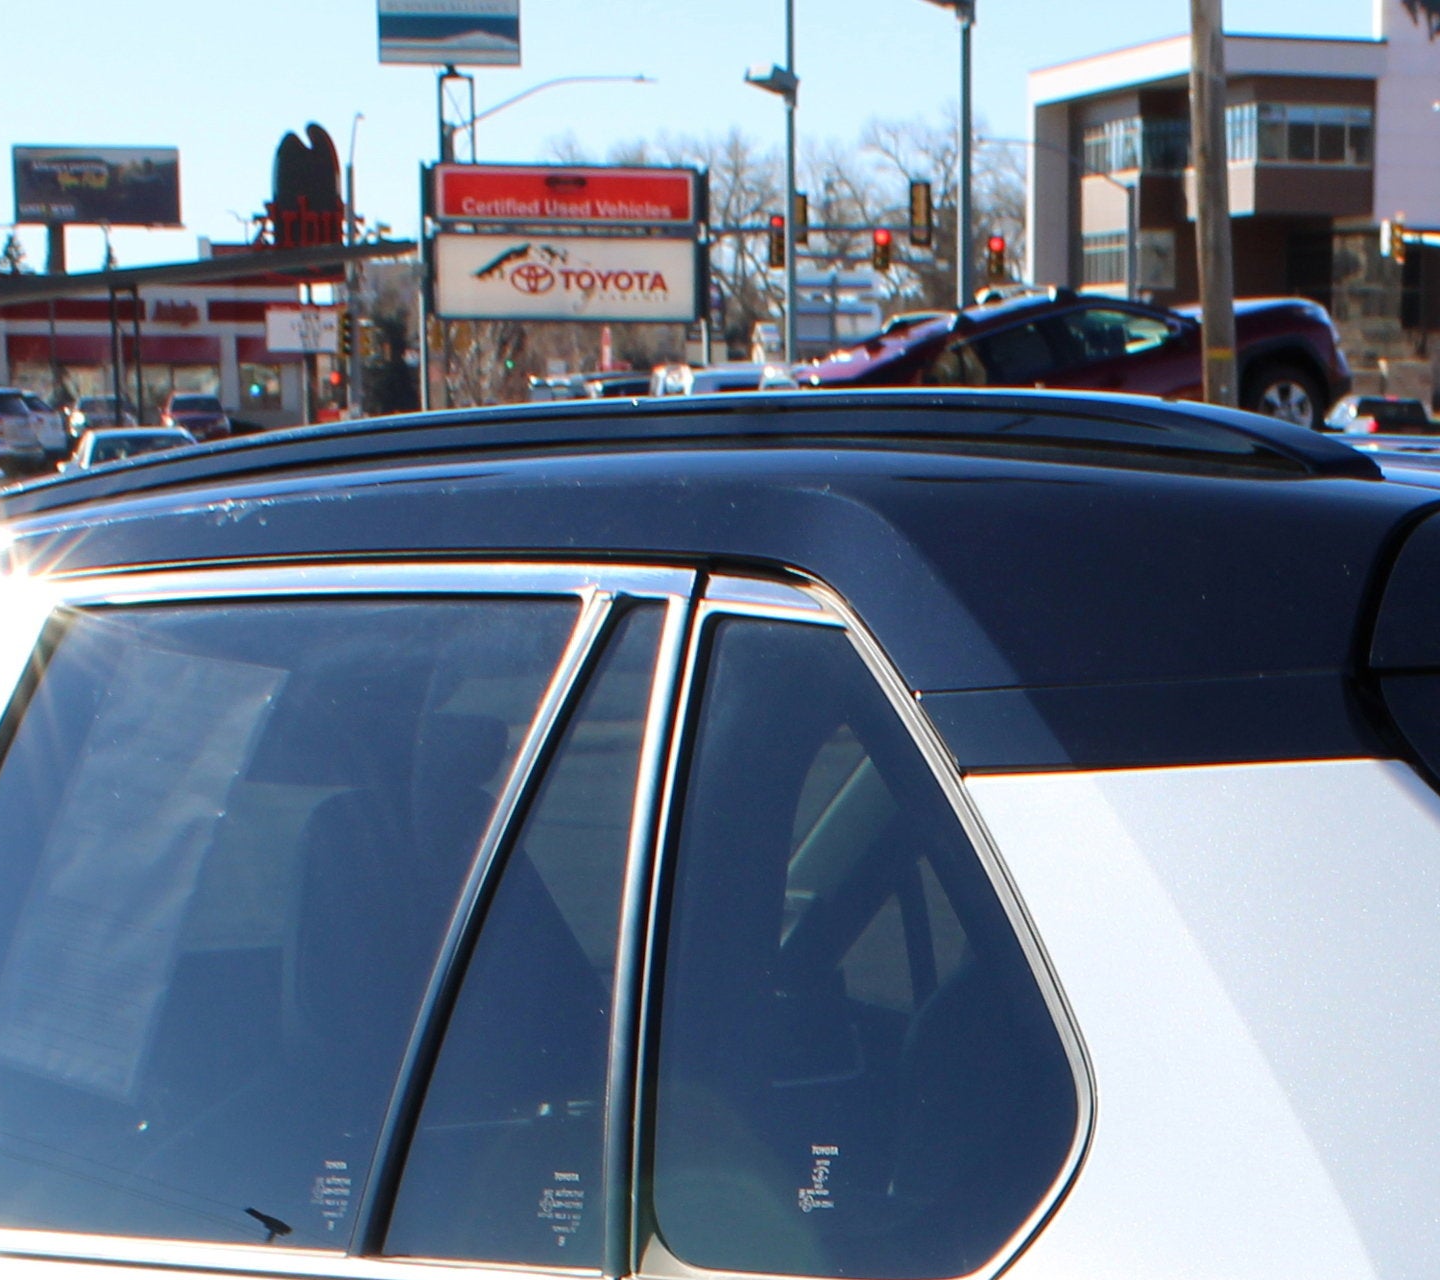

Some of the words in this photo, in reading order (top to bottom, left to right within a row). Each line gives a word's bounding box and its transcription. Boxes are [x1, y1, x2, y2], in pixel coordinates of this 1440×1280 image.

[462, 196, 540, 217] Certified
[544, 198, 591, 217] Used
[594, 200, 672, 218] Vehicles
[558, 269, 668, 292] TOYOTA
[811, 1145, 839, 1156] TOYOTA
